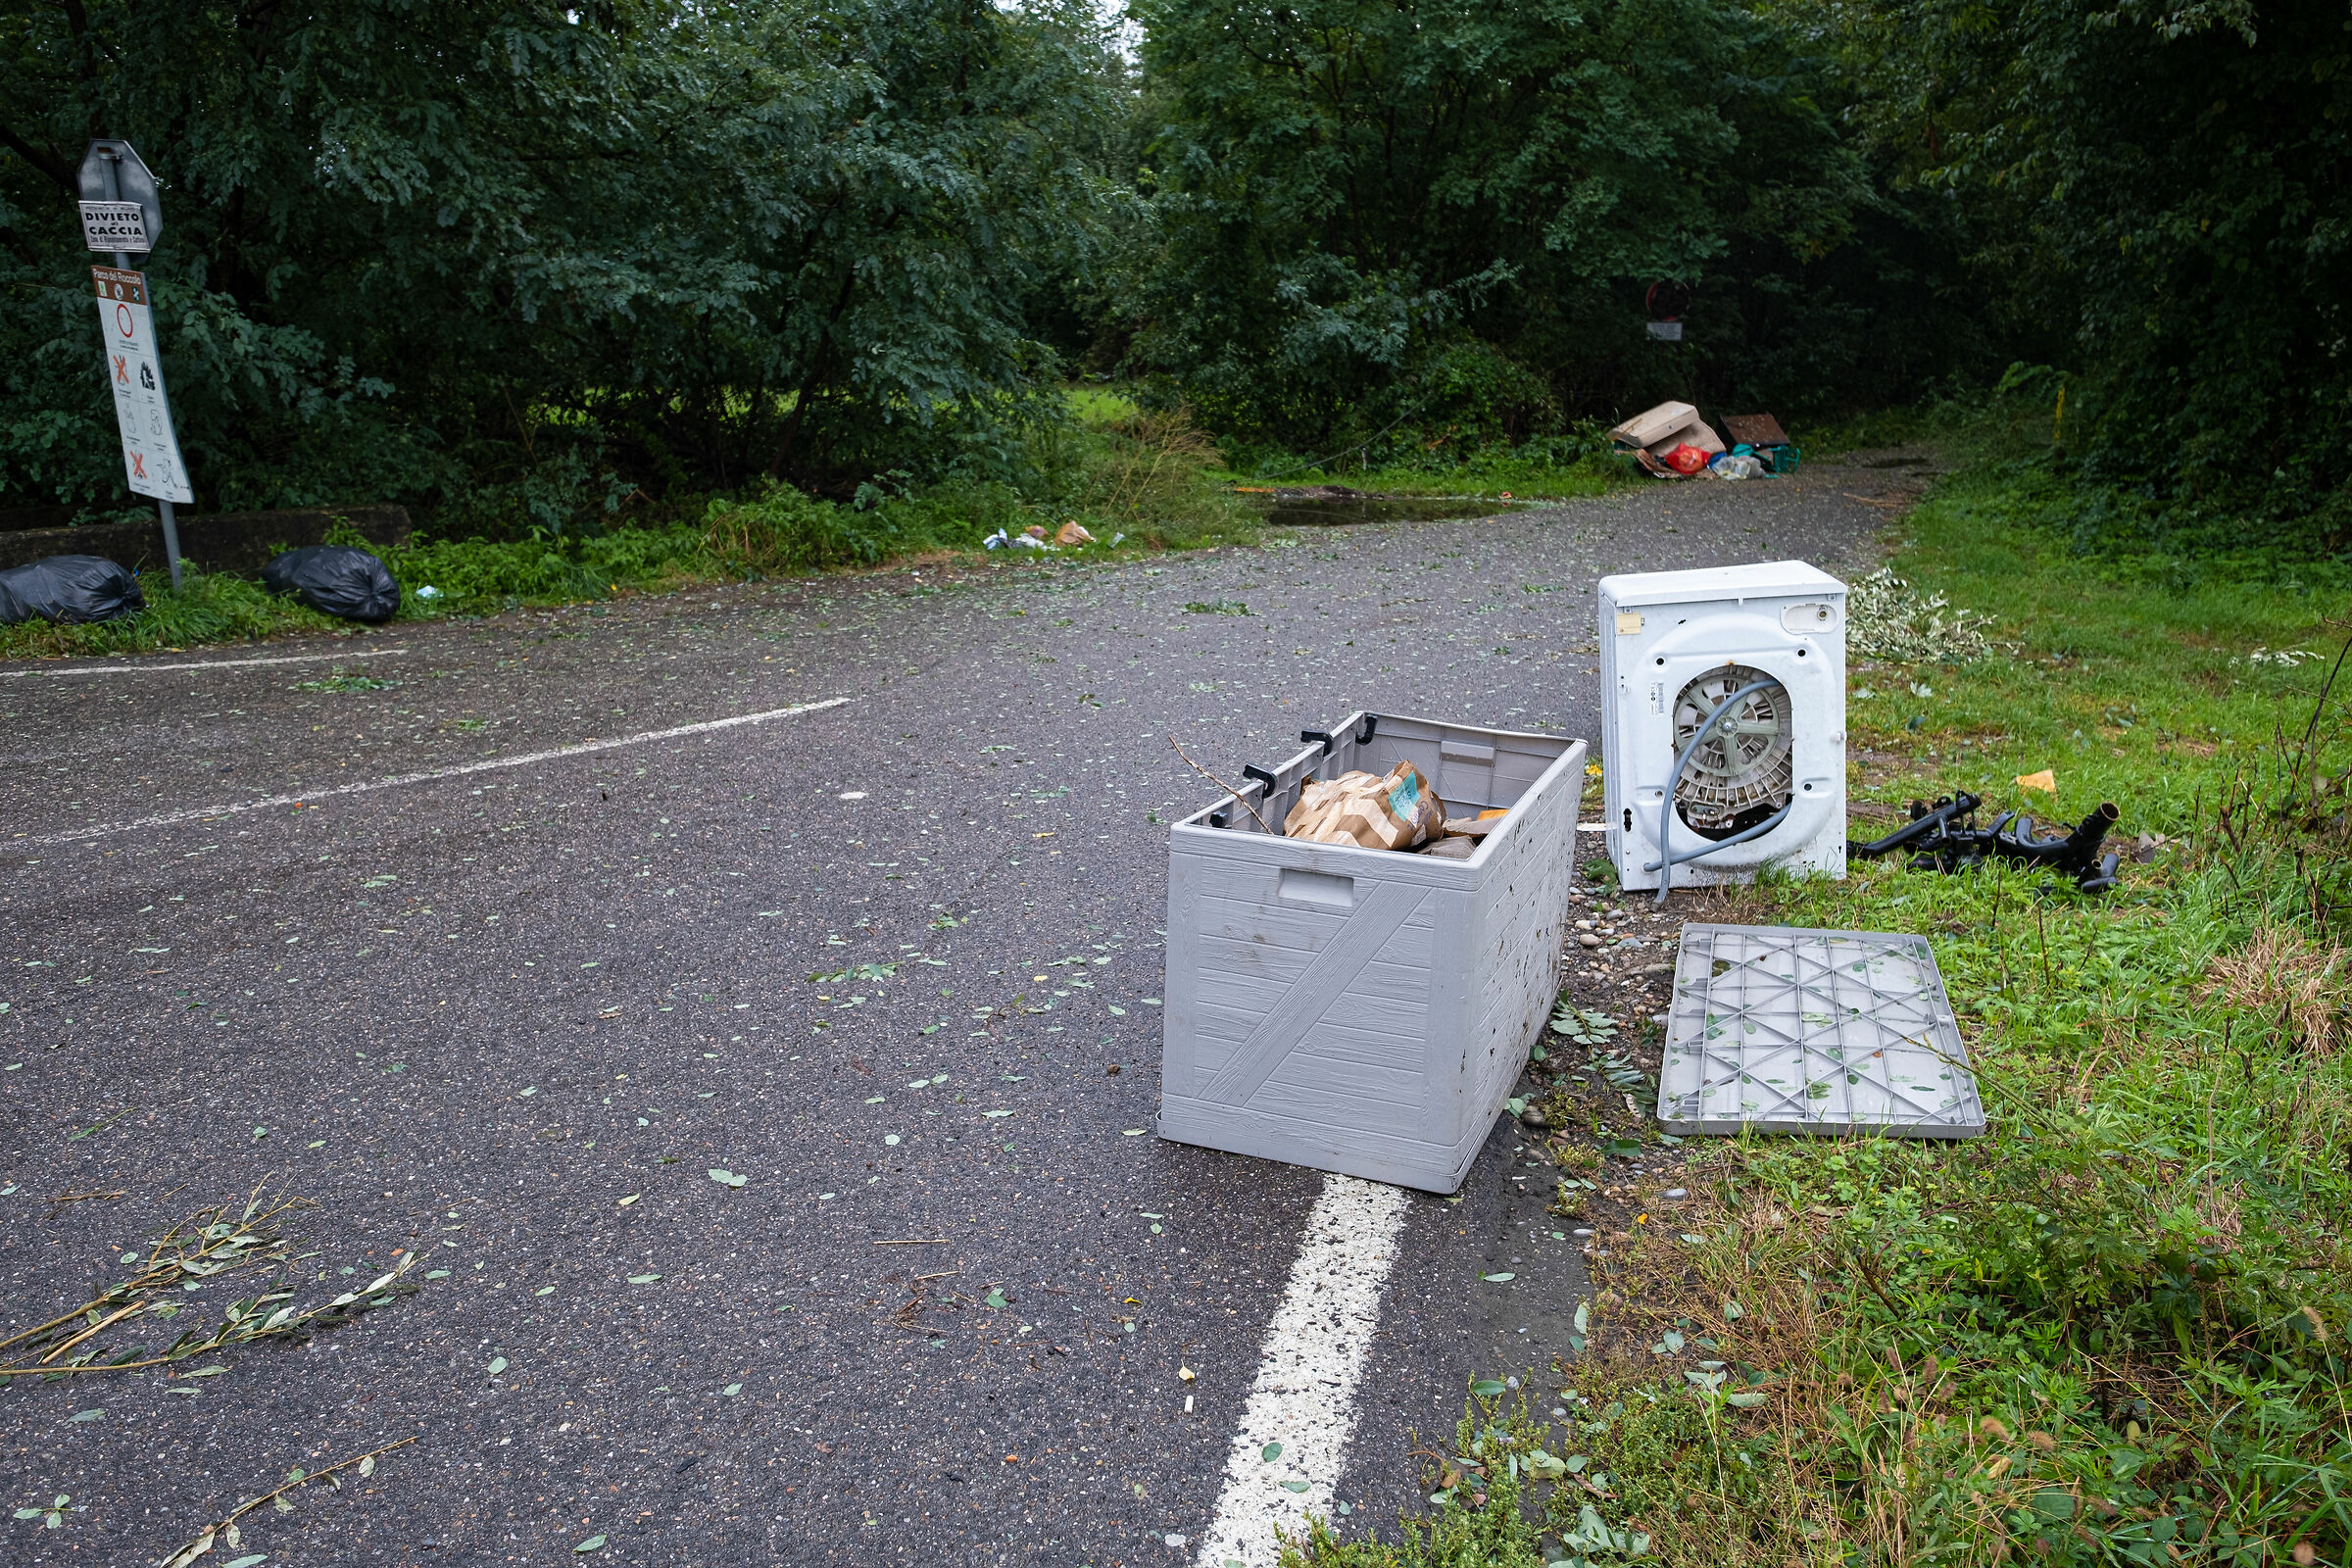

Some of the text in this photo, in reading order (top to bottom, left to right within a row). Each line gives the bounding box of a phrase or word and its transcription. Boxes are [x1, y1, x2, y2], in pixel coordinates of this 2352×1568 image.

[85, 213, 139, 221] DIVIETO
[89, 226, 142, 235] CACCIA
[93, 268, 108, 280] Parco
[109, 270, 117, 281] del
